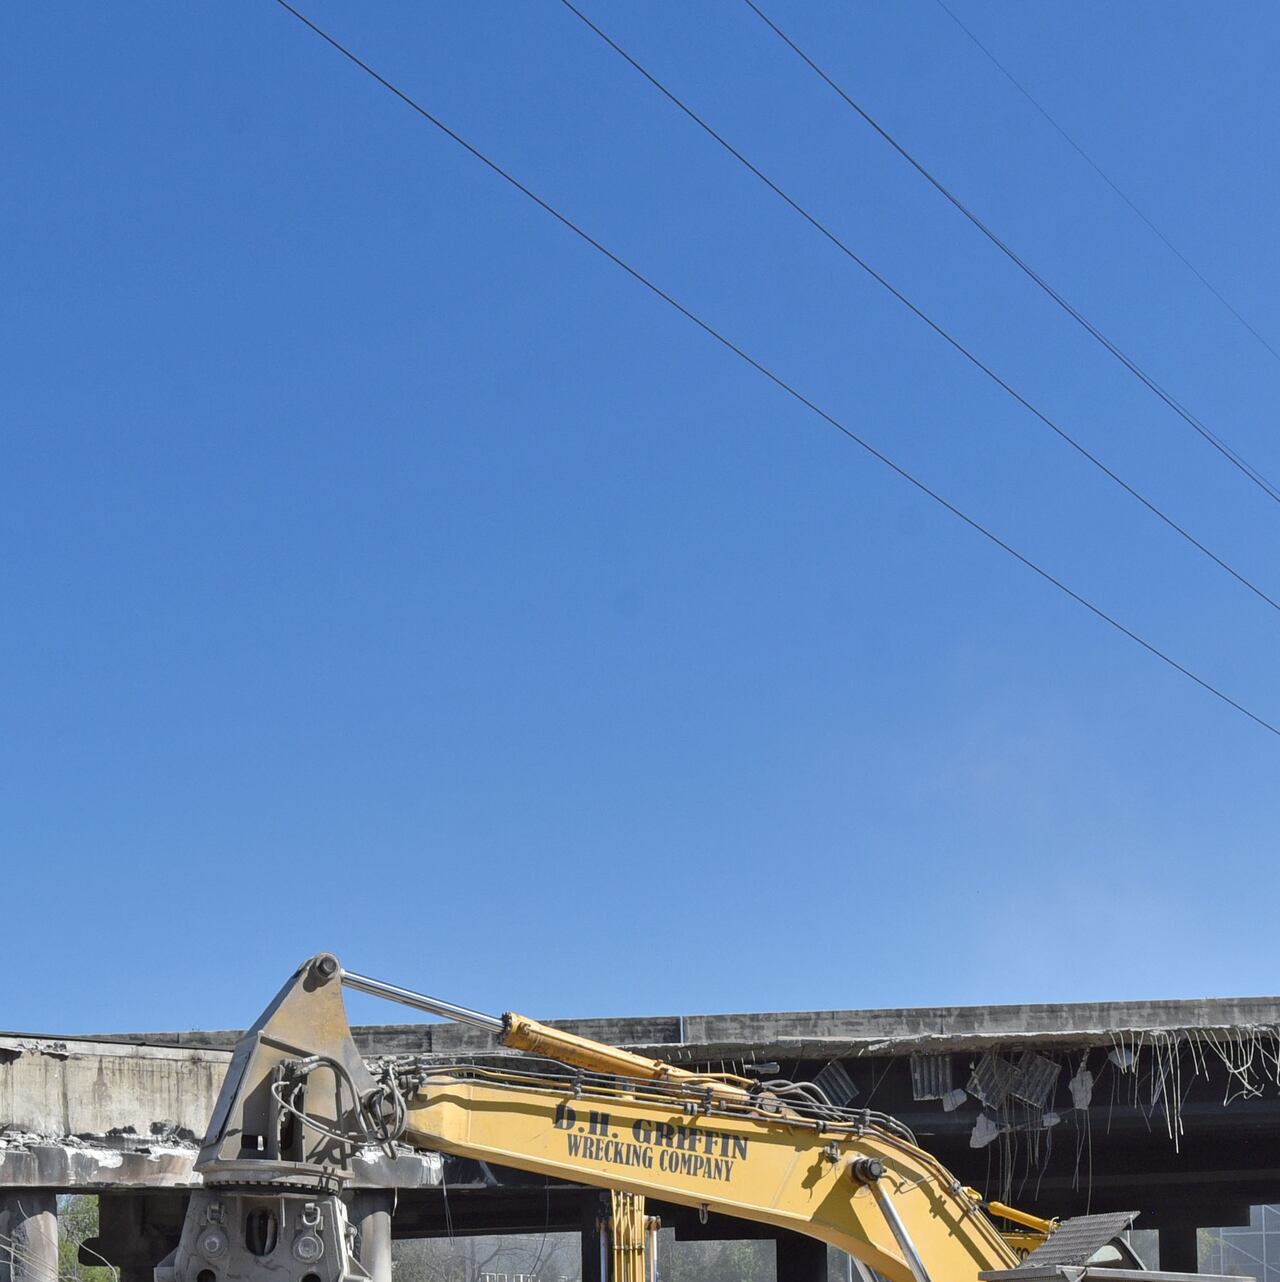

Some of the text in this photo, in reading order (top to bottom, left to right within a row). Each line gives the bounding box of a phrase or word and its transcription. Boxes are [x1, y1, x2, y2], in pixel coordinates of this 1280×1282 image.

[553, 1104, 750, 1161] D.H. GRIFFIN
[567, 1133, 734, 1182] WRECKING COMPANY
